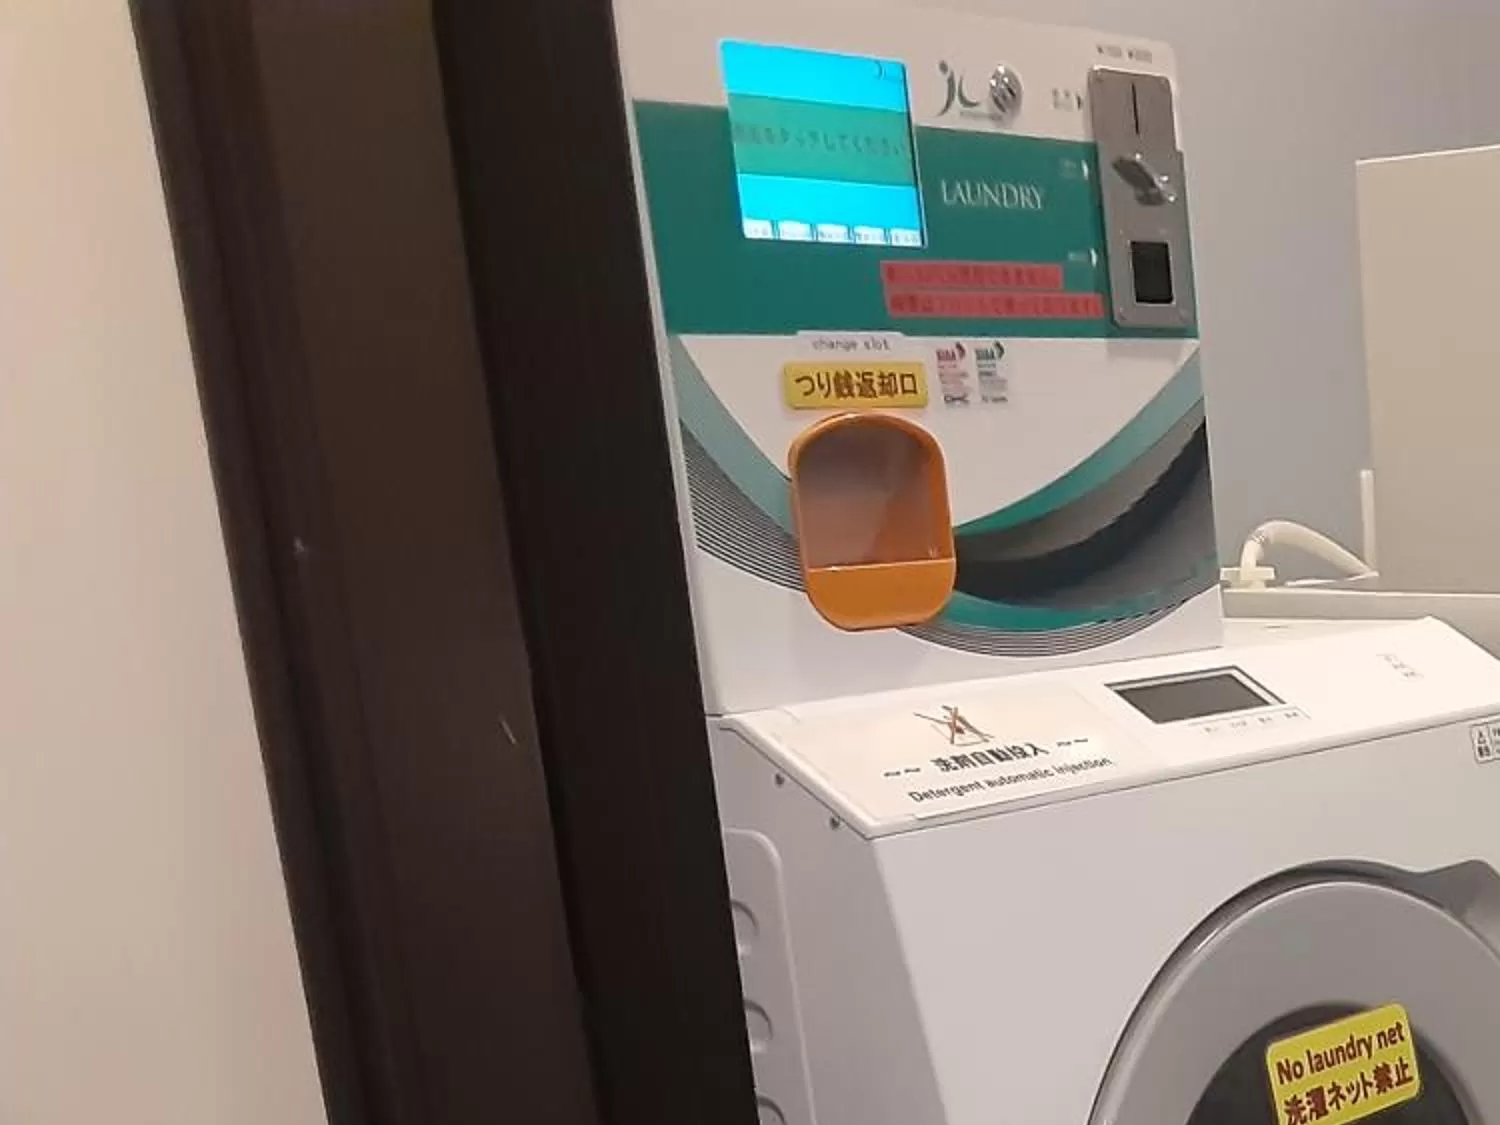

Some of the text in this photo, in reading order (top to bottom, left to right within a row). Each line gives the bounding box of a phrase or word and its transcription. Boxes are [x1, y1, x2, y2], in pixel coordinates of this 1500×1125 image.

[941, 178, 1043, 209] LAUNDRY
[812, 336, 891, 352] change slot
[795, 369, 917, 398] つり銭返却口
[908, 757, 1112, 802] Detergent automatic injection
[1276, 1021, 1405, 1085] No laundry net
